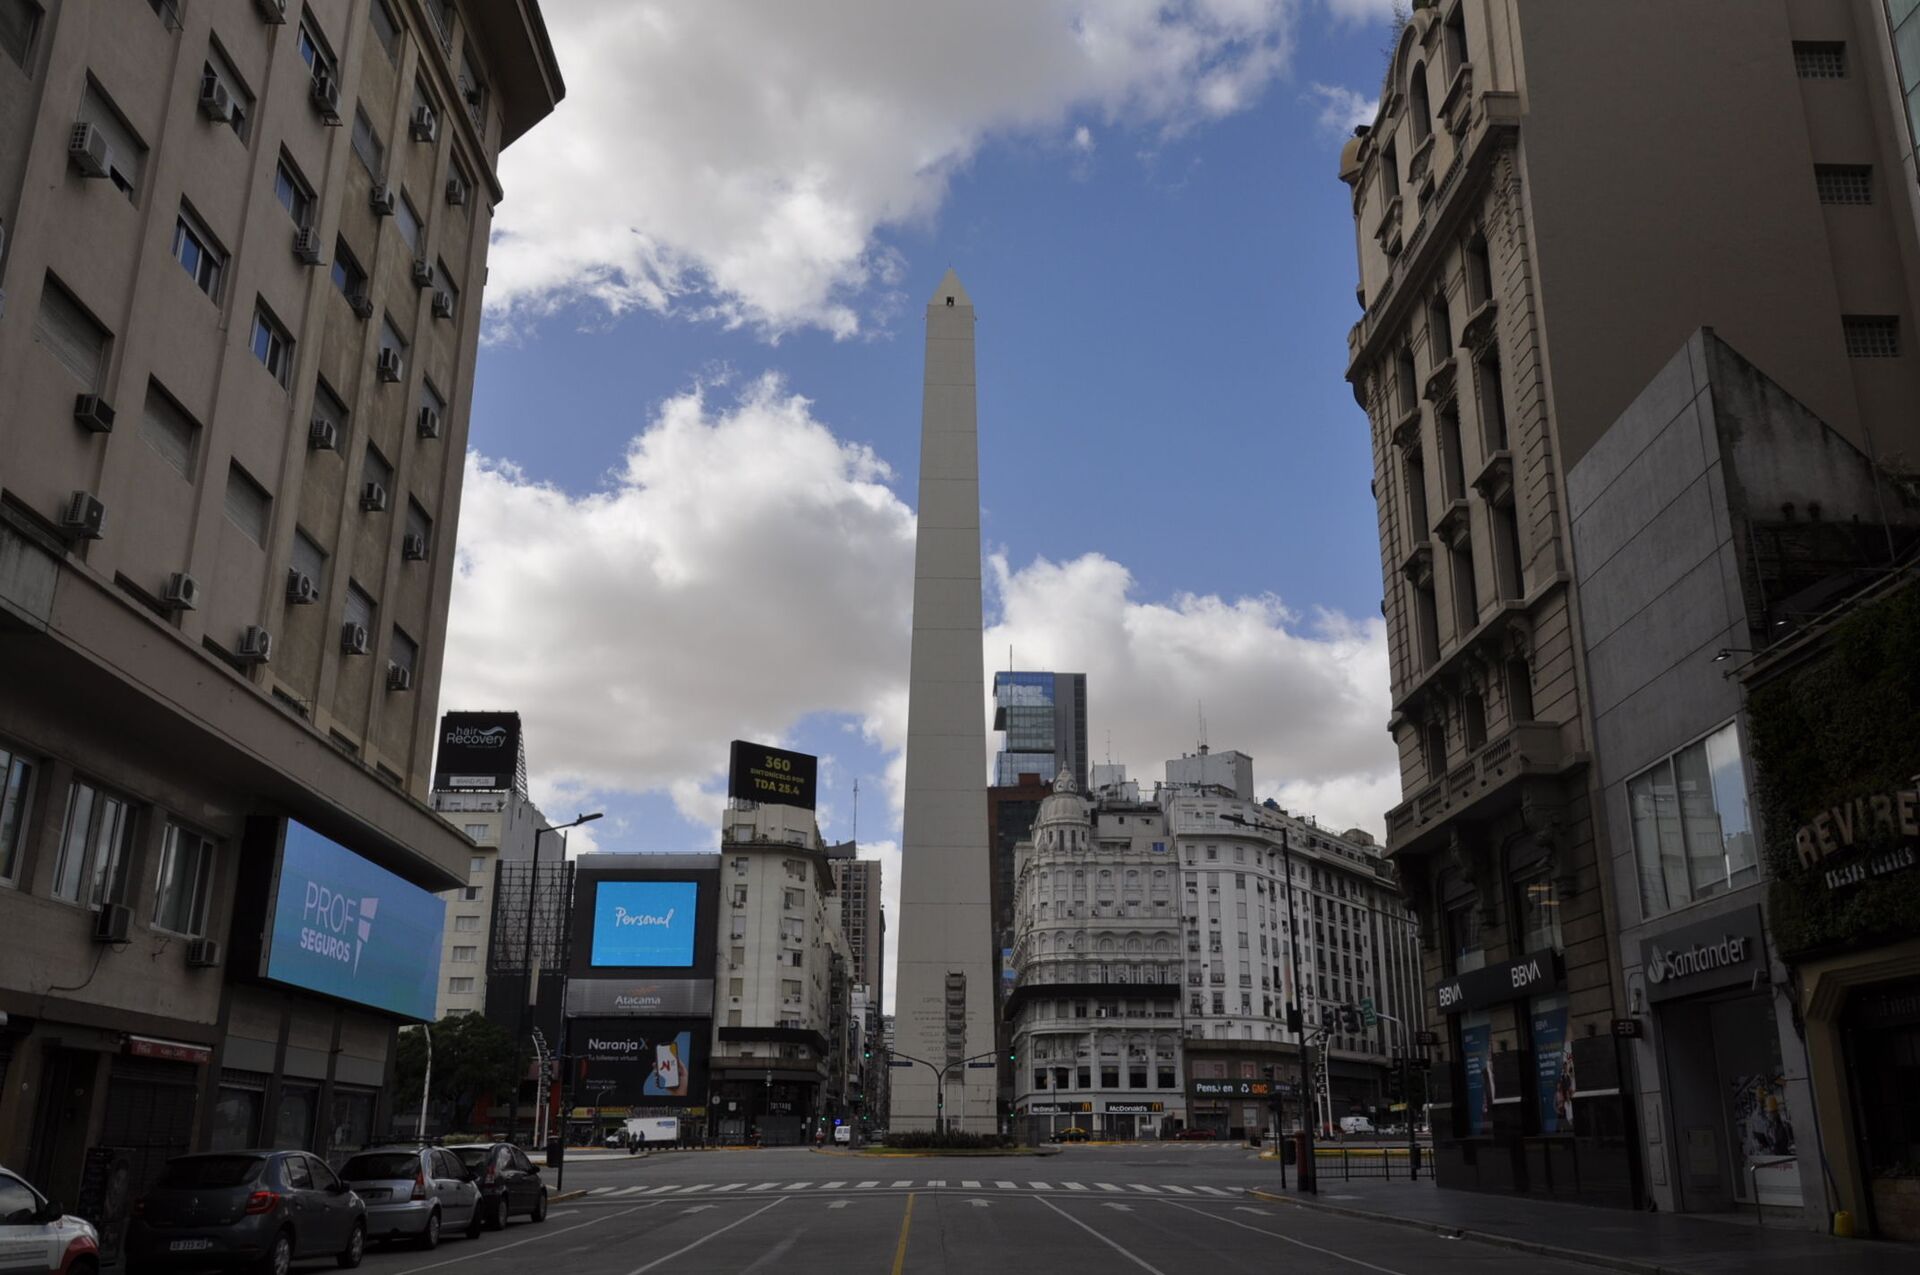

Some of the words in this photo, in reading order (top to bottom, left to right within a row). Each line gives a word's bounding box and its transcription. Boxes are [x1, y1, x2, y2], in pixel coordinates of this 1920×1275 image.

[456, 725, 479, 735] hair
[446, 732, 506, 747] Recovery
[765, 755, 791, 772] 360
[754, 778, 776, 792] TDA
[778, 783, 799, 795] 25.4
[303, 880, 356, 935] PROF
[615, 906, 675, 929] Personal
[300, 926, 351, 963] SEGUROS
[1664, 931, 1746, 980] Santander
[1511, 959, 1541, 988] BBVA
[614, 995, 661, 1005] Atacama
[1439, 982, 1463, 1007] BBVA
[588, 1038, 639, 1053] Naranja
[1251, 1084, 1269, 1095] GNC
[1109, 1104, 1148, 1113] McDonald's
